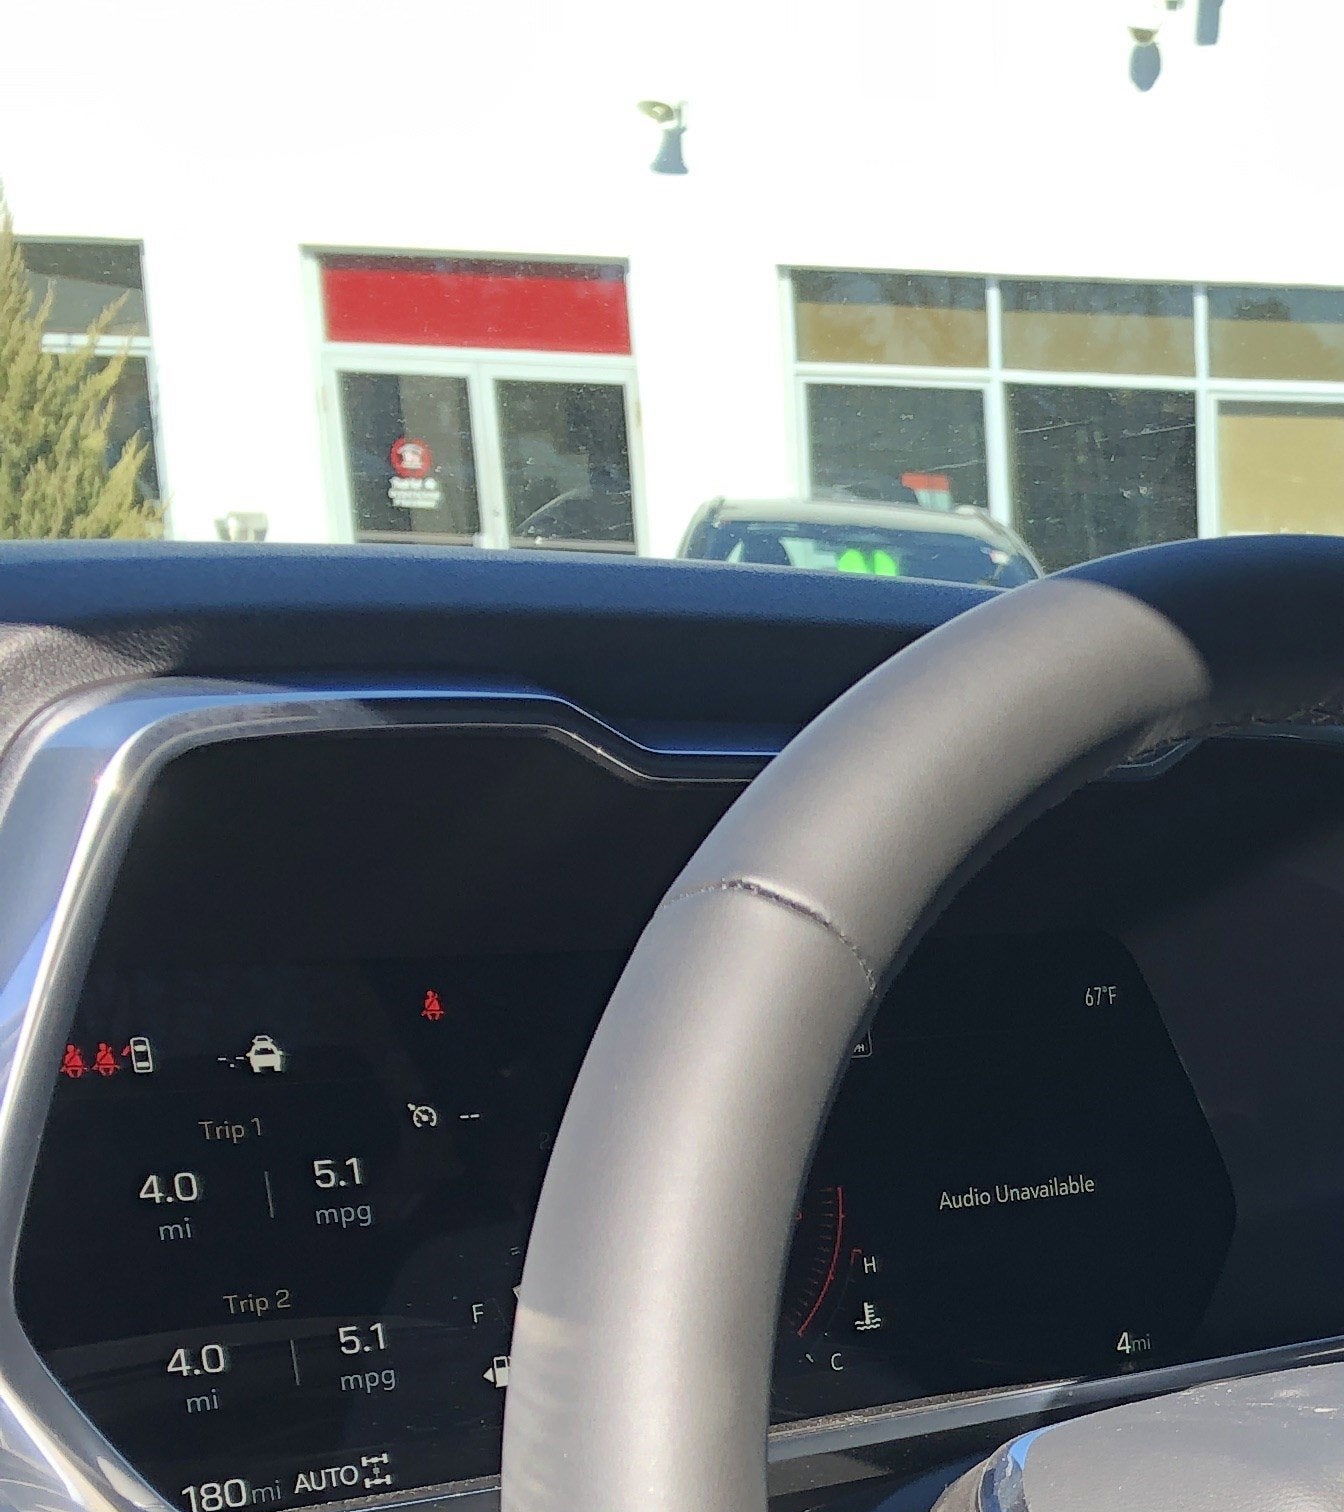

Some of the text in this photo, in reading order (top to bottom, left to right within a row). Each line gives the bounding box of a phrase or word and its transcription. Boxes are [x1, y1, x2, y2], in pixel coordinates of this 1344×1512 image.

[1084, 984, 1118, 1007] 67°F
[199, 1117, 264, 1145] Trip 1
[312, 1156, 364, 1190] 5.1
[138, 1172, 199, 1205] 4.0
[938, 1174, 1096, 1211] Audio Unavailable
[315, 1202, 372, 1228] mpg
[158, 1216, 193, 1242] mi
[862, 1255, 877, 1275] H
[223, 1288, 291, 1317] Trip 2
[471, 1303, 484, 1324] F
[338, 1322, 387, 1355] 5.1
[166, 1343, 226, 1378] 4.0
[830, 1352, 844, 1372] C
[340, 1367, 396, 1392] mpg
[186, 1388, 219, 1414] mi
[293, 1464, 360, 1497] AUTO
